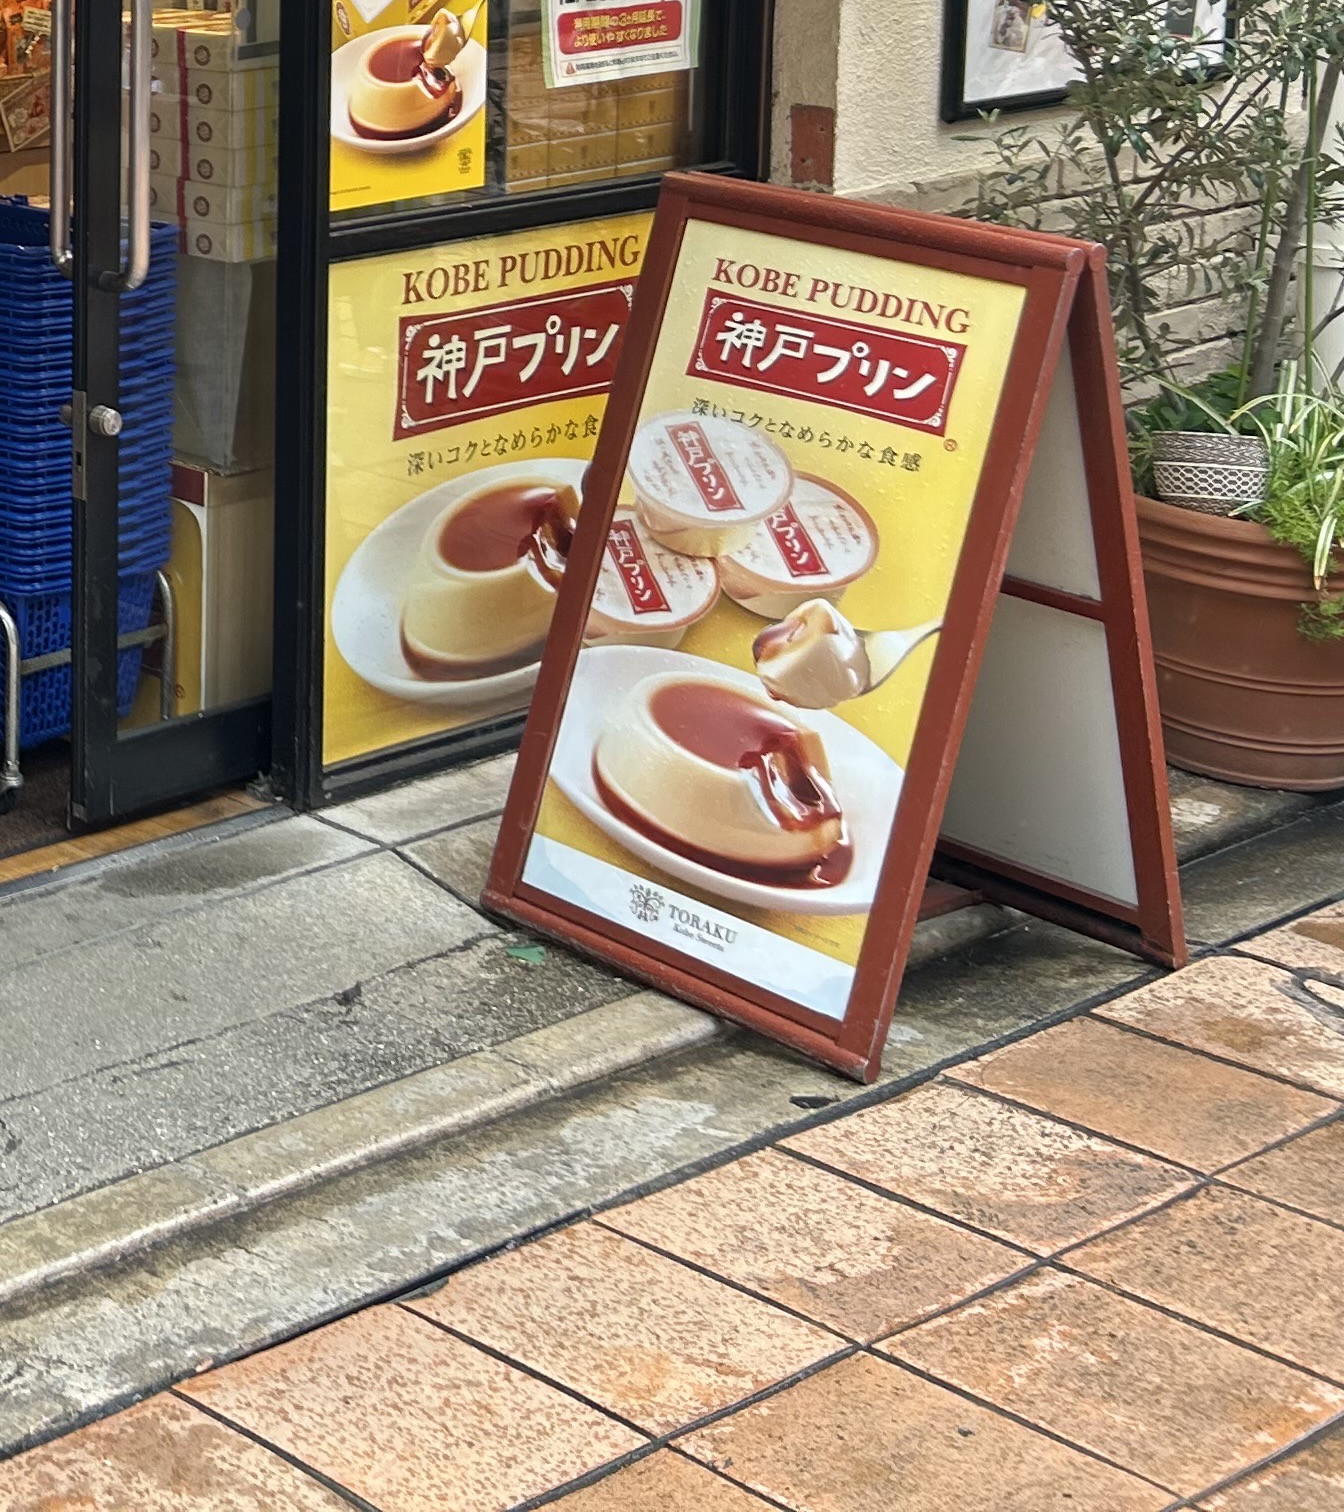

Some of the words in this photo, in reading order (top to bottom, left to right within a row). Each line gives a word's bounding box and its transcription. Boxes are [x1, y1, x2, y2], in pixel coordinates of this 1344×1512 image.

[401, 259, 490, 305] KOBE
[498, 234, 640, 288] PUDDING
[712, 257, 801, 299] KOBE
[811, 281, 972, 334] PUDDING
[416, 314, 621, 407] 神戸プリン
[715, 311, 938, 401] 神戸プリン
[690, 396, 923, 474] 深いコクとなめらかな食感
[669, 904, 738, 944] TORAKU
